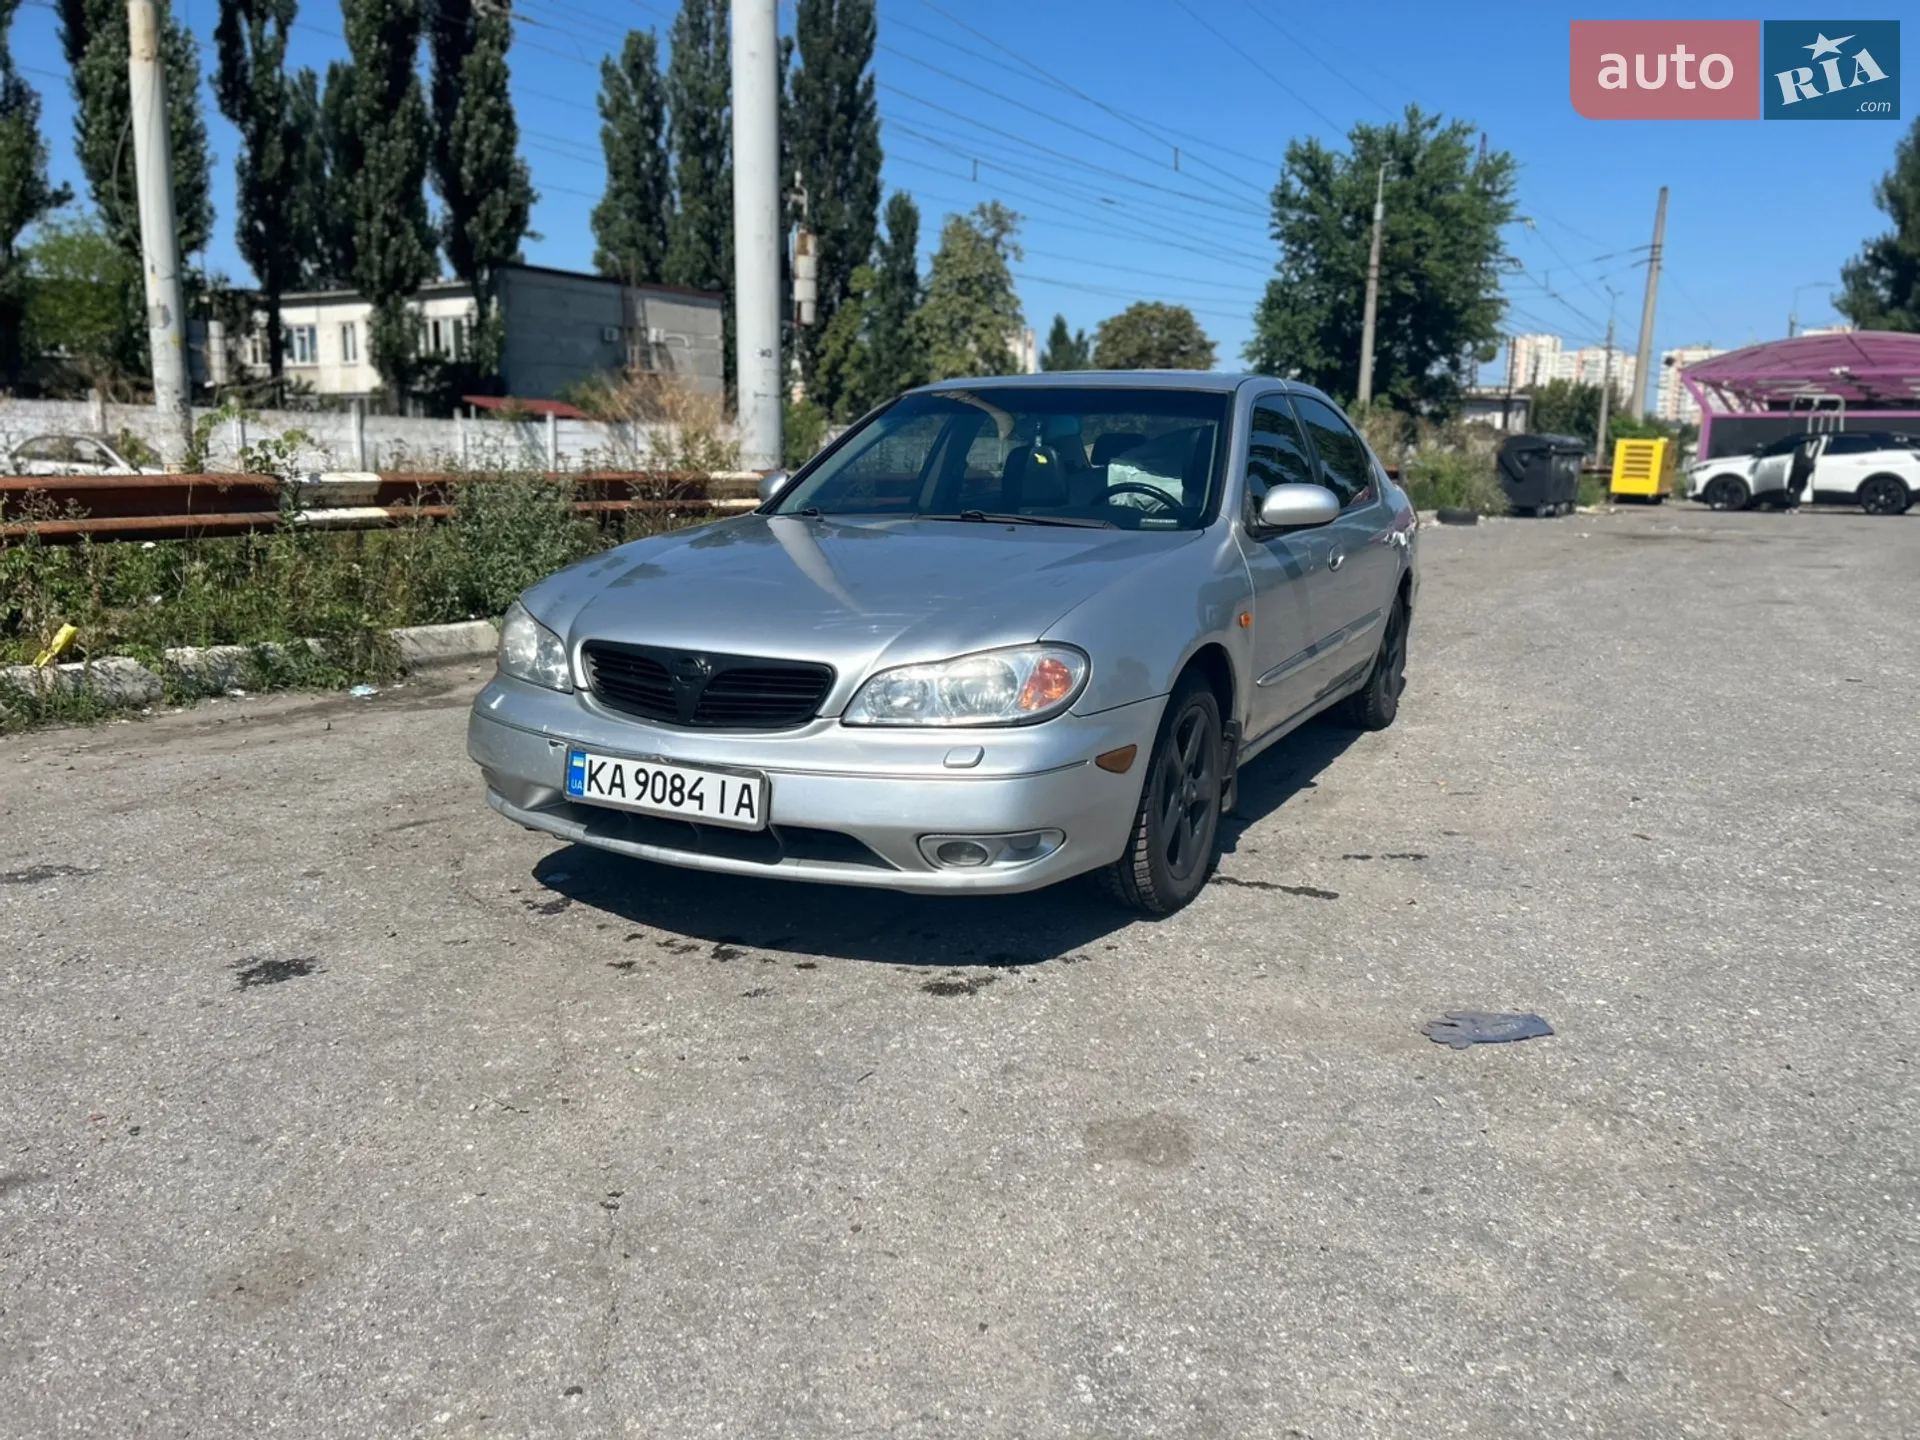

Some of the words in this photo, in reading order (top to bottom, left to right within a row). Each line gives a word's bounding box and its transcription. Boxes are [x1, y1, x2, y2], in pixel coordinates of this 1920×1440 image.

[571, 778, 583, 790] UA
[587, 759, 626, 798] KA
[634, 767, 704, 811] 9084
[719, 779, 756, 819] IA
